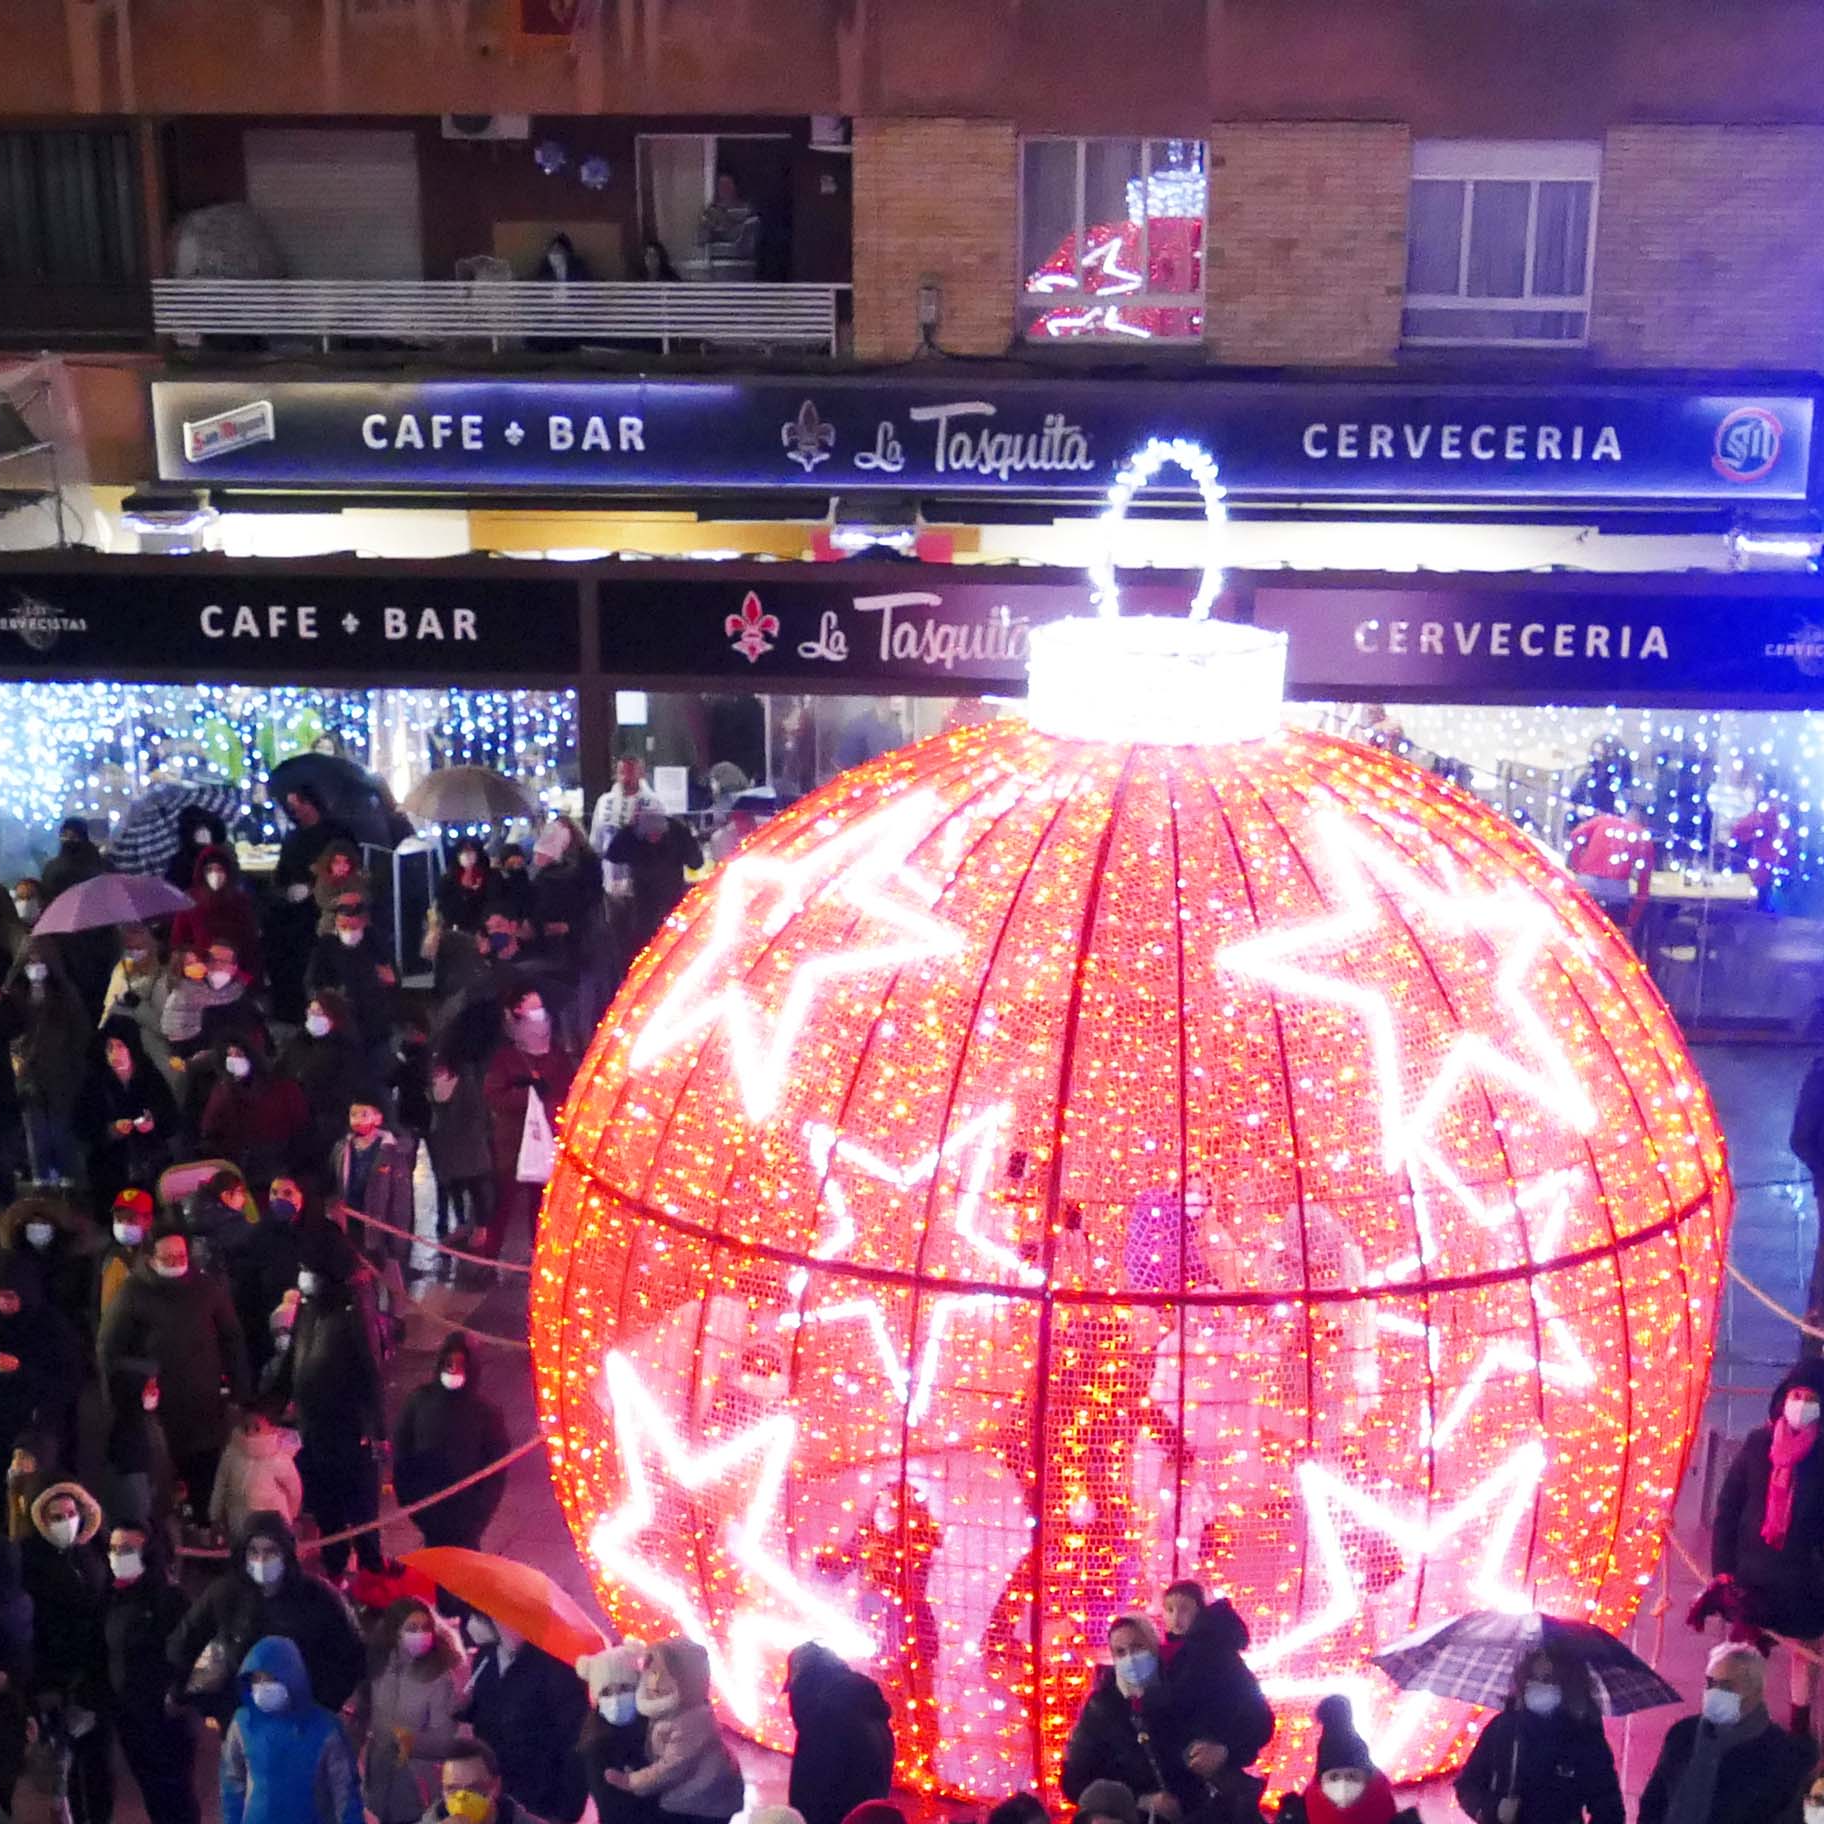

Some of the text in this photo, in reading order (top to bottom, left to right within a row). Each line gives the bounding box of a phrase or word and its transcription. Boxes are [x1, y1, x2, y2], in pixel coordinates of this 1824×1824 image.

[361, 413, 646, 452] CAFE BAR
[854, 401, 1095, 481] La Tasquita
[1302, 423, 1622, 461] CERVECERIA
[199, 605, 478, 641] CAFE BAR
[797, 610, 849, 662] La
[1354, 620, 1669, 660] CERVECERIA
